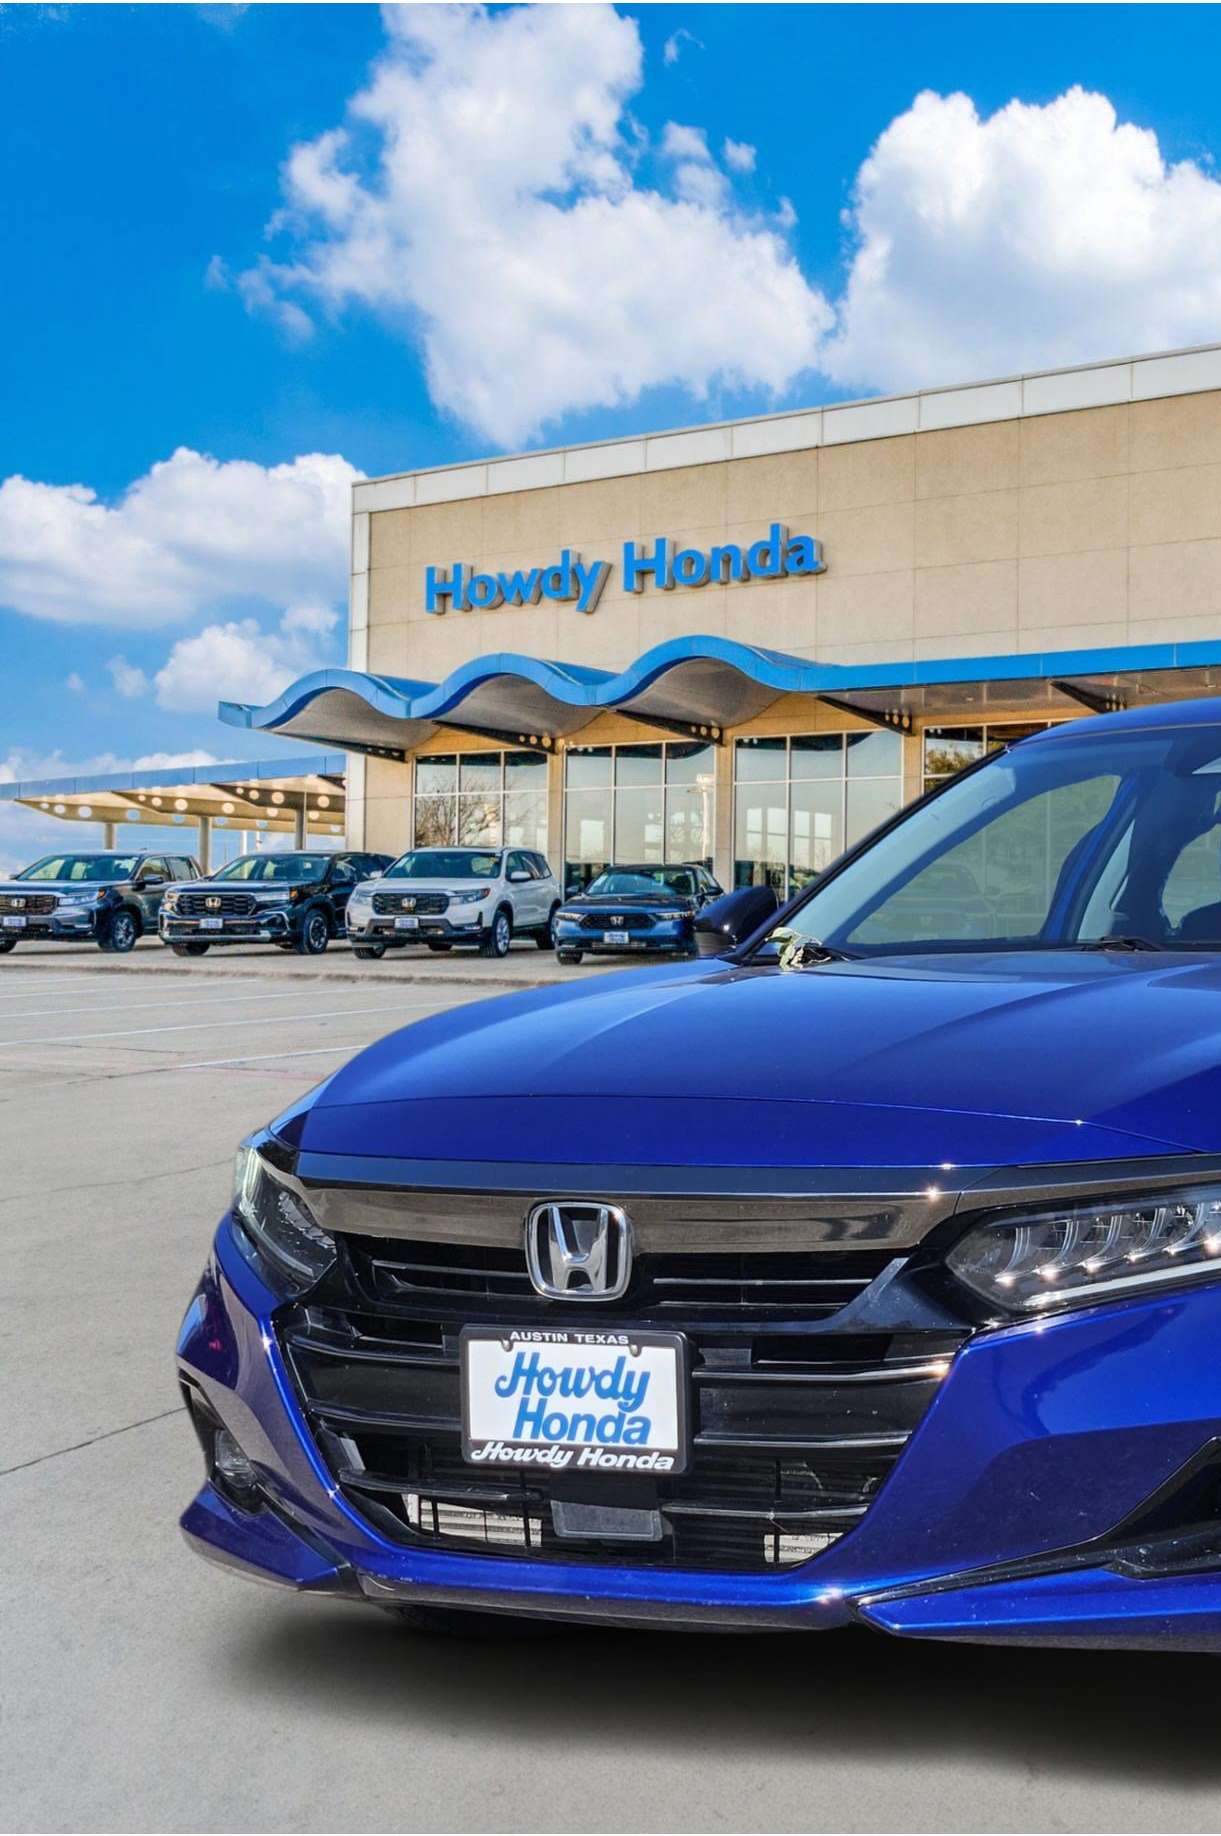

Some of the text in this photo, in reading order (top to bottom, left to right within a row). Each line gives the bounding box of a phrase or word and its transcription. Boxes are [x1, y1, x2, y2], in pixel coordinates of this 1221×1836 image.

[425, 523, 826, 615] Howdy Honda
[509, 1331, 629, 1345] AUSTIN TEXAS
[494, 1351, 651, 1413] Howdy
[512, 1397, 651, 1445] Honda
[470, 1441, 675, 1471] Howdy Honda
